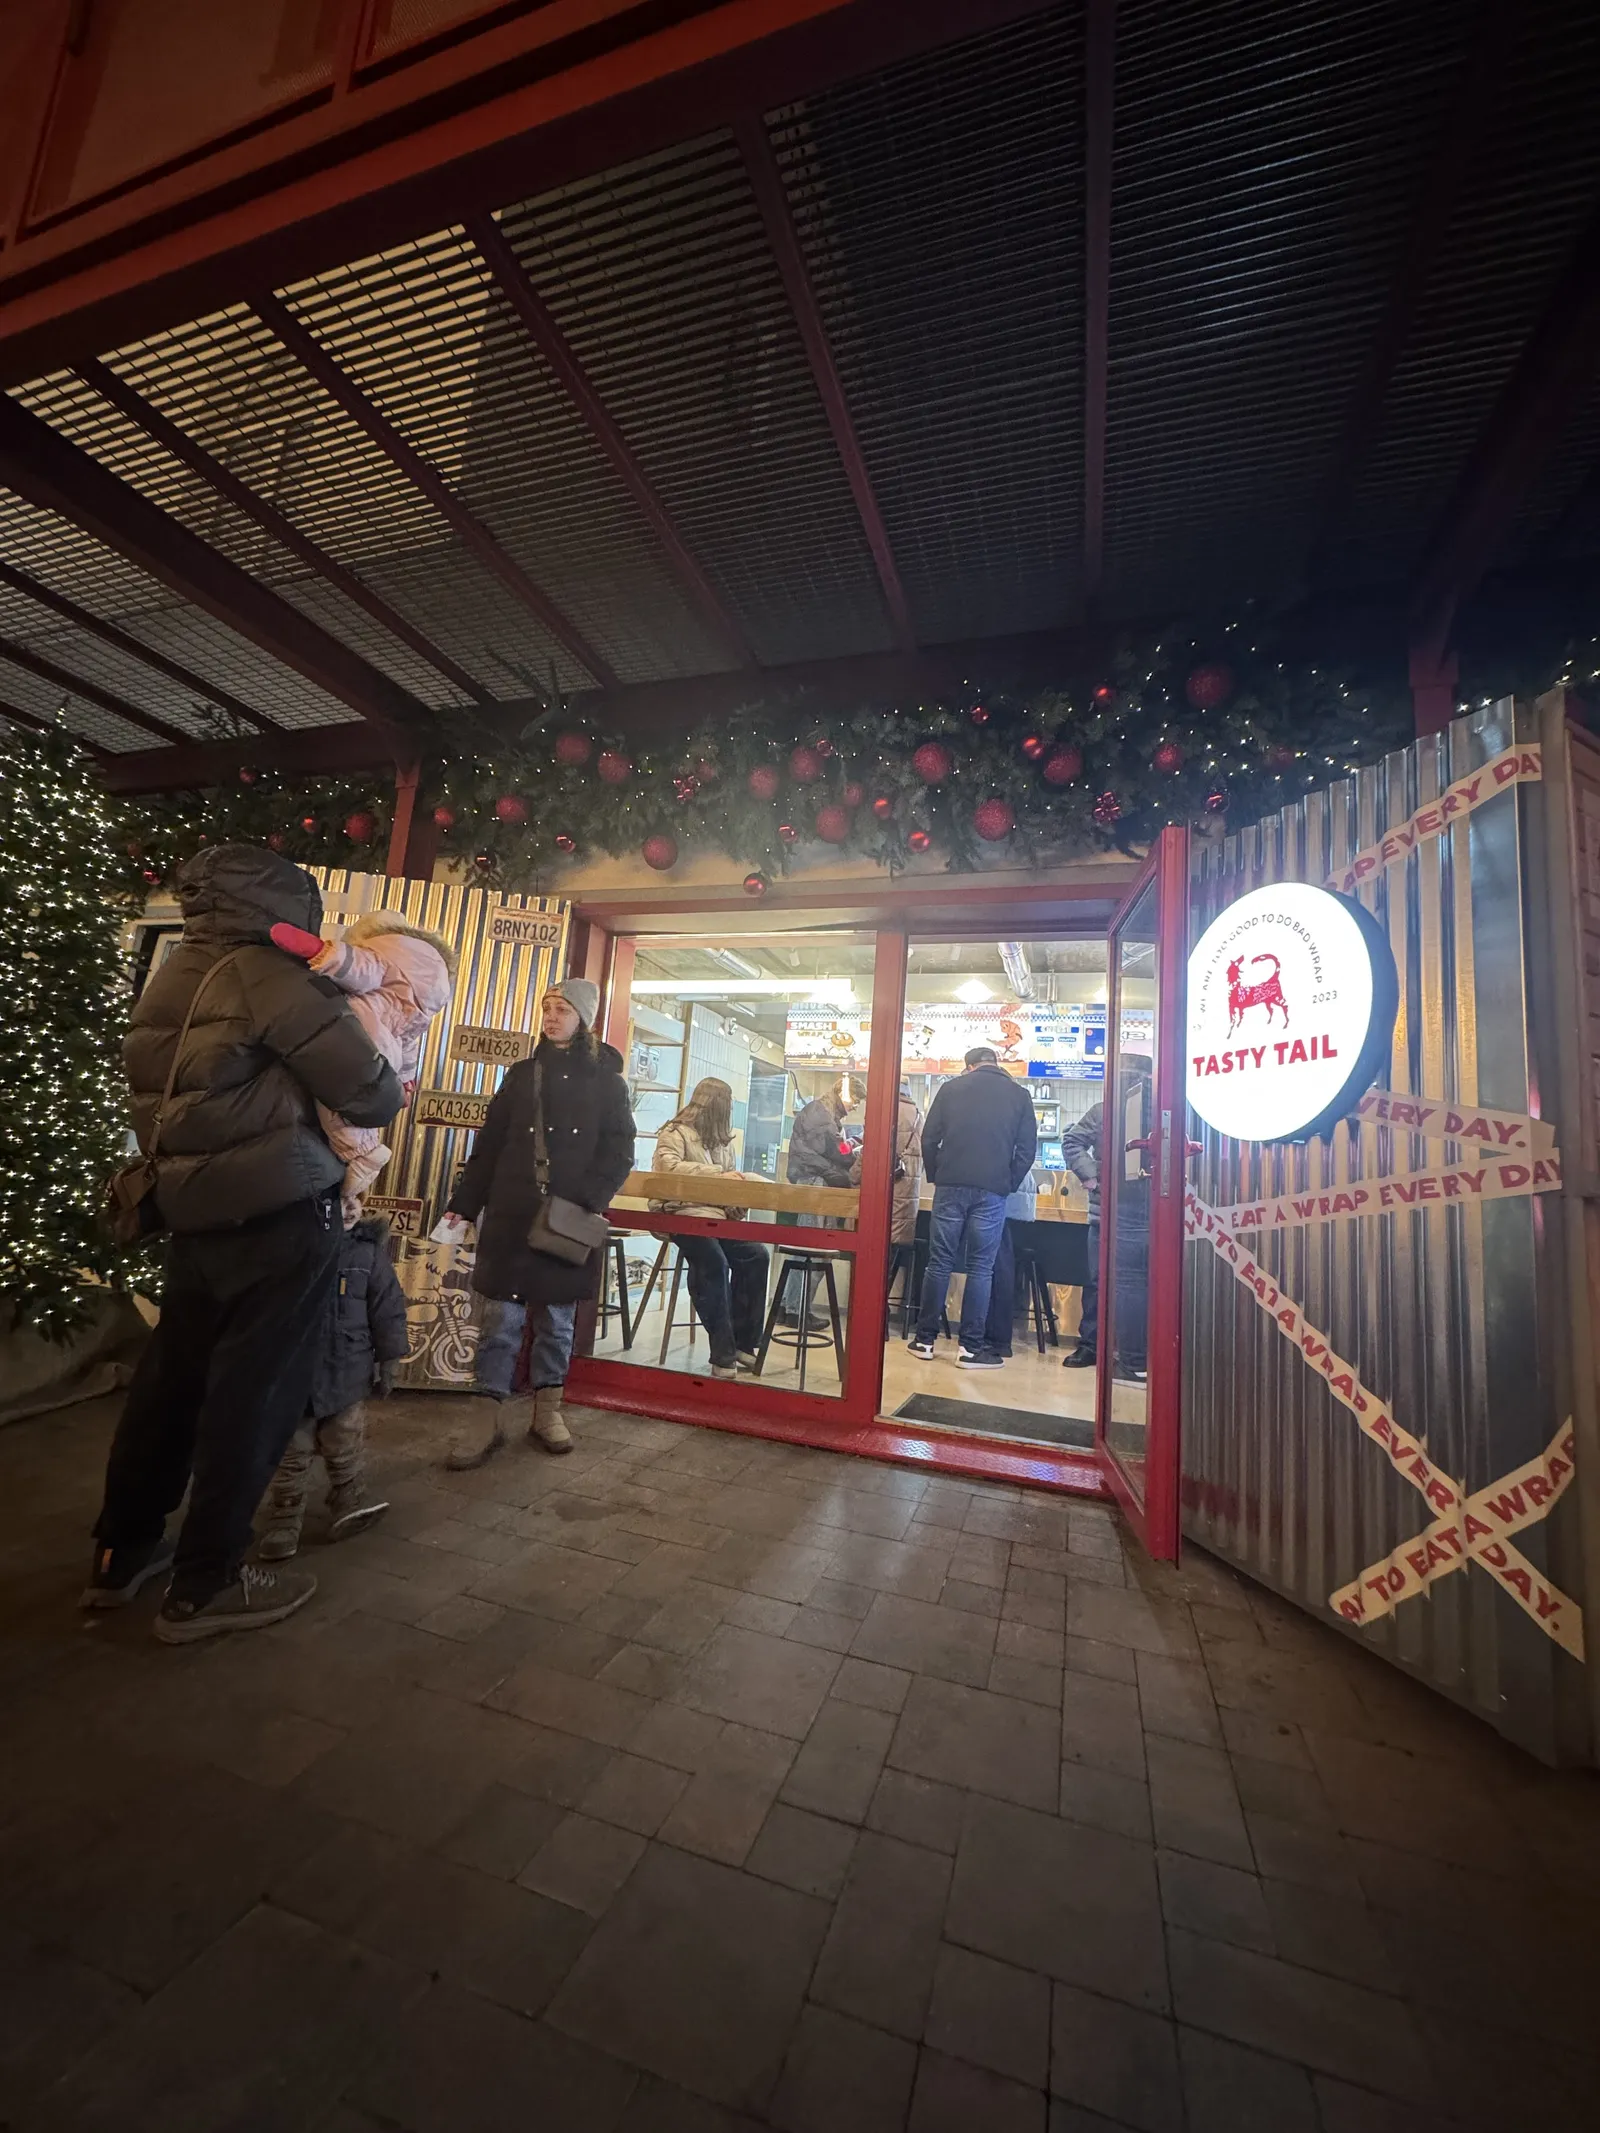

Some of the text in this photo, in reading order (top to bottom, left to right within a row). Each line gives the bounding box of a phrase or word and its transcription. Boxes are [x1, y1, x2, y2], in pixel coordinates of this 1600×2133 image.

[1381, 776, 1482, 863] EVERY
[493, 918, 558, 943] 8RNY102
[1229, 917, 1259, 941] GOOD
[1262, 913, 1275, 923] TO
[1277, 914, 1292, 927] DO
[1292, 921, 1311, 943] BAD
[1308, 942, 1323, 984] WRAP
[1312, 990, 1338, 1004] 2023
[790, 1021, 833, 1031] SMASH
[1193, 1034, 1338, 1077] TASTY TAIL
[1444, 1112, 1526, 1148] DAY.
[370, 1199, 397, 1207] UTAH
[1231, 1207, 1266, 1229] EAT
[1275, 1204, 1287, 1223] A
[1291, 1189, 1370, 1220] WRAP
[1379, 1168, 1487, 1206] EVERY
[1215, 1229, 1239, 1263] TO
[1240, 1261, 1279, 1308] EAT
[1277, 1308, 1296, 1333] A
[1300, 1325, 1368, 1412] WRAP
[1371, 1414, 1463, 1512] EVER
[1478, 1543, 1562, 1631] DAY.
[1365, 1566, 1406, 1602] TO
[1405, 1526, 1464, 1578] EAT
[1463, 1513, 1494, 1545] A
